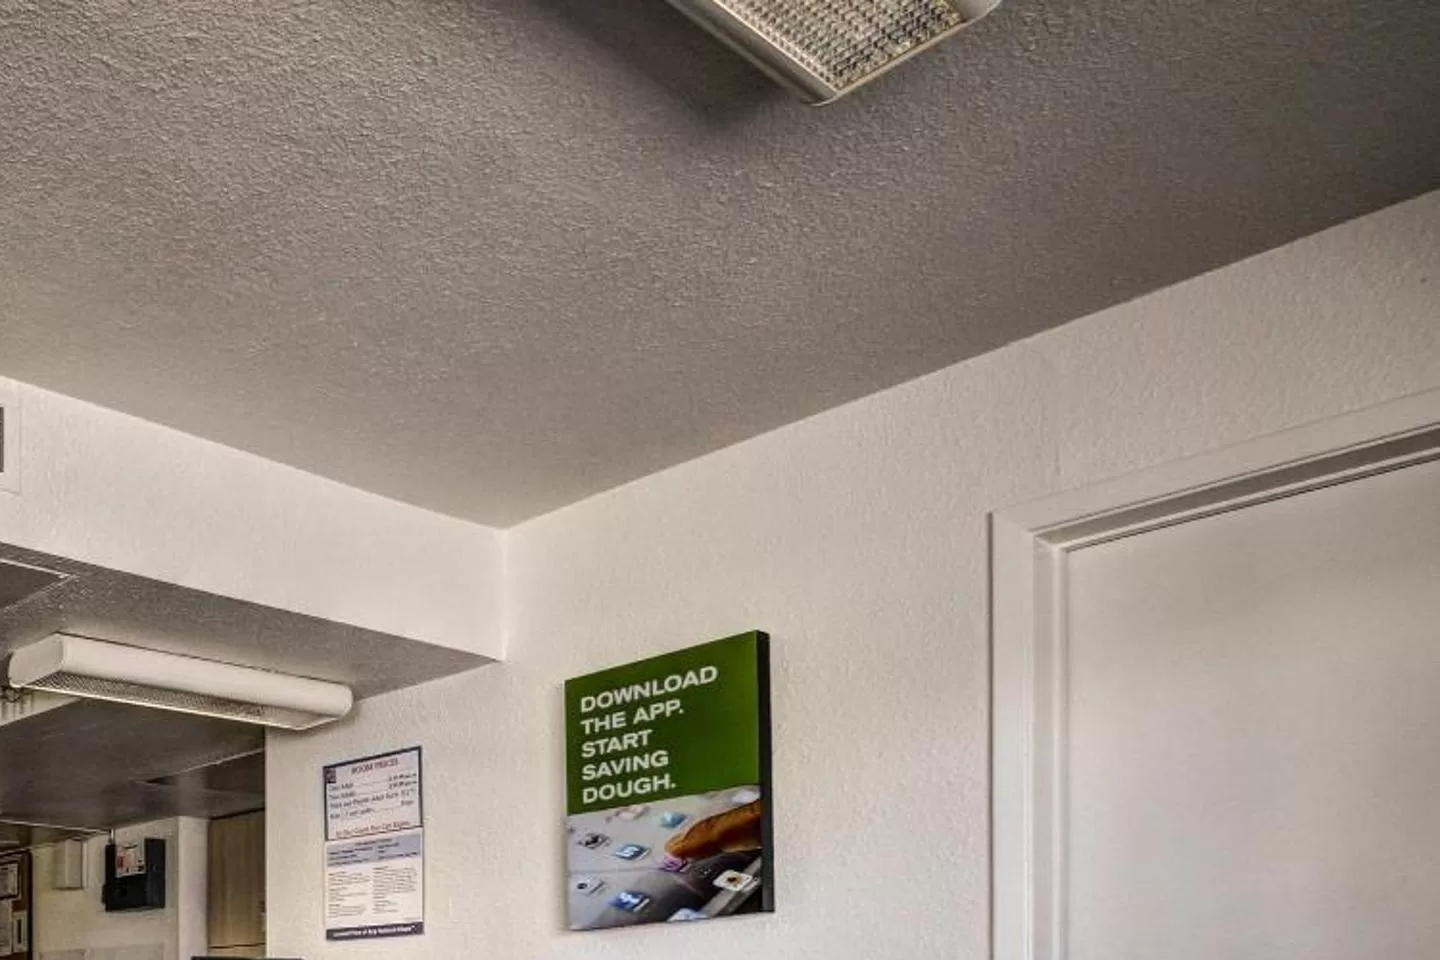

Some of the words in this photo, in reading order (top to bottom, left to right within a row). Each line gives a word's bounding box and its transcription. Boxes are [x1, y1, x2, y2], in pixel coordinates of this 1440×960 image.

[580, 665, 718, 713] DOWNLOAD
[580, 711, 627, 735] THE
[633, 699, 684, 724] APP.
[581, 729, 653, 758] START
[581, 750, 670, 781] SAVING
[582, 773, 677, 804] DOUGH.
